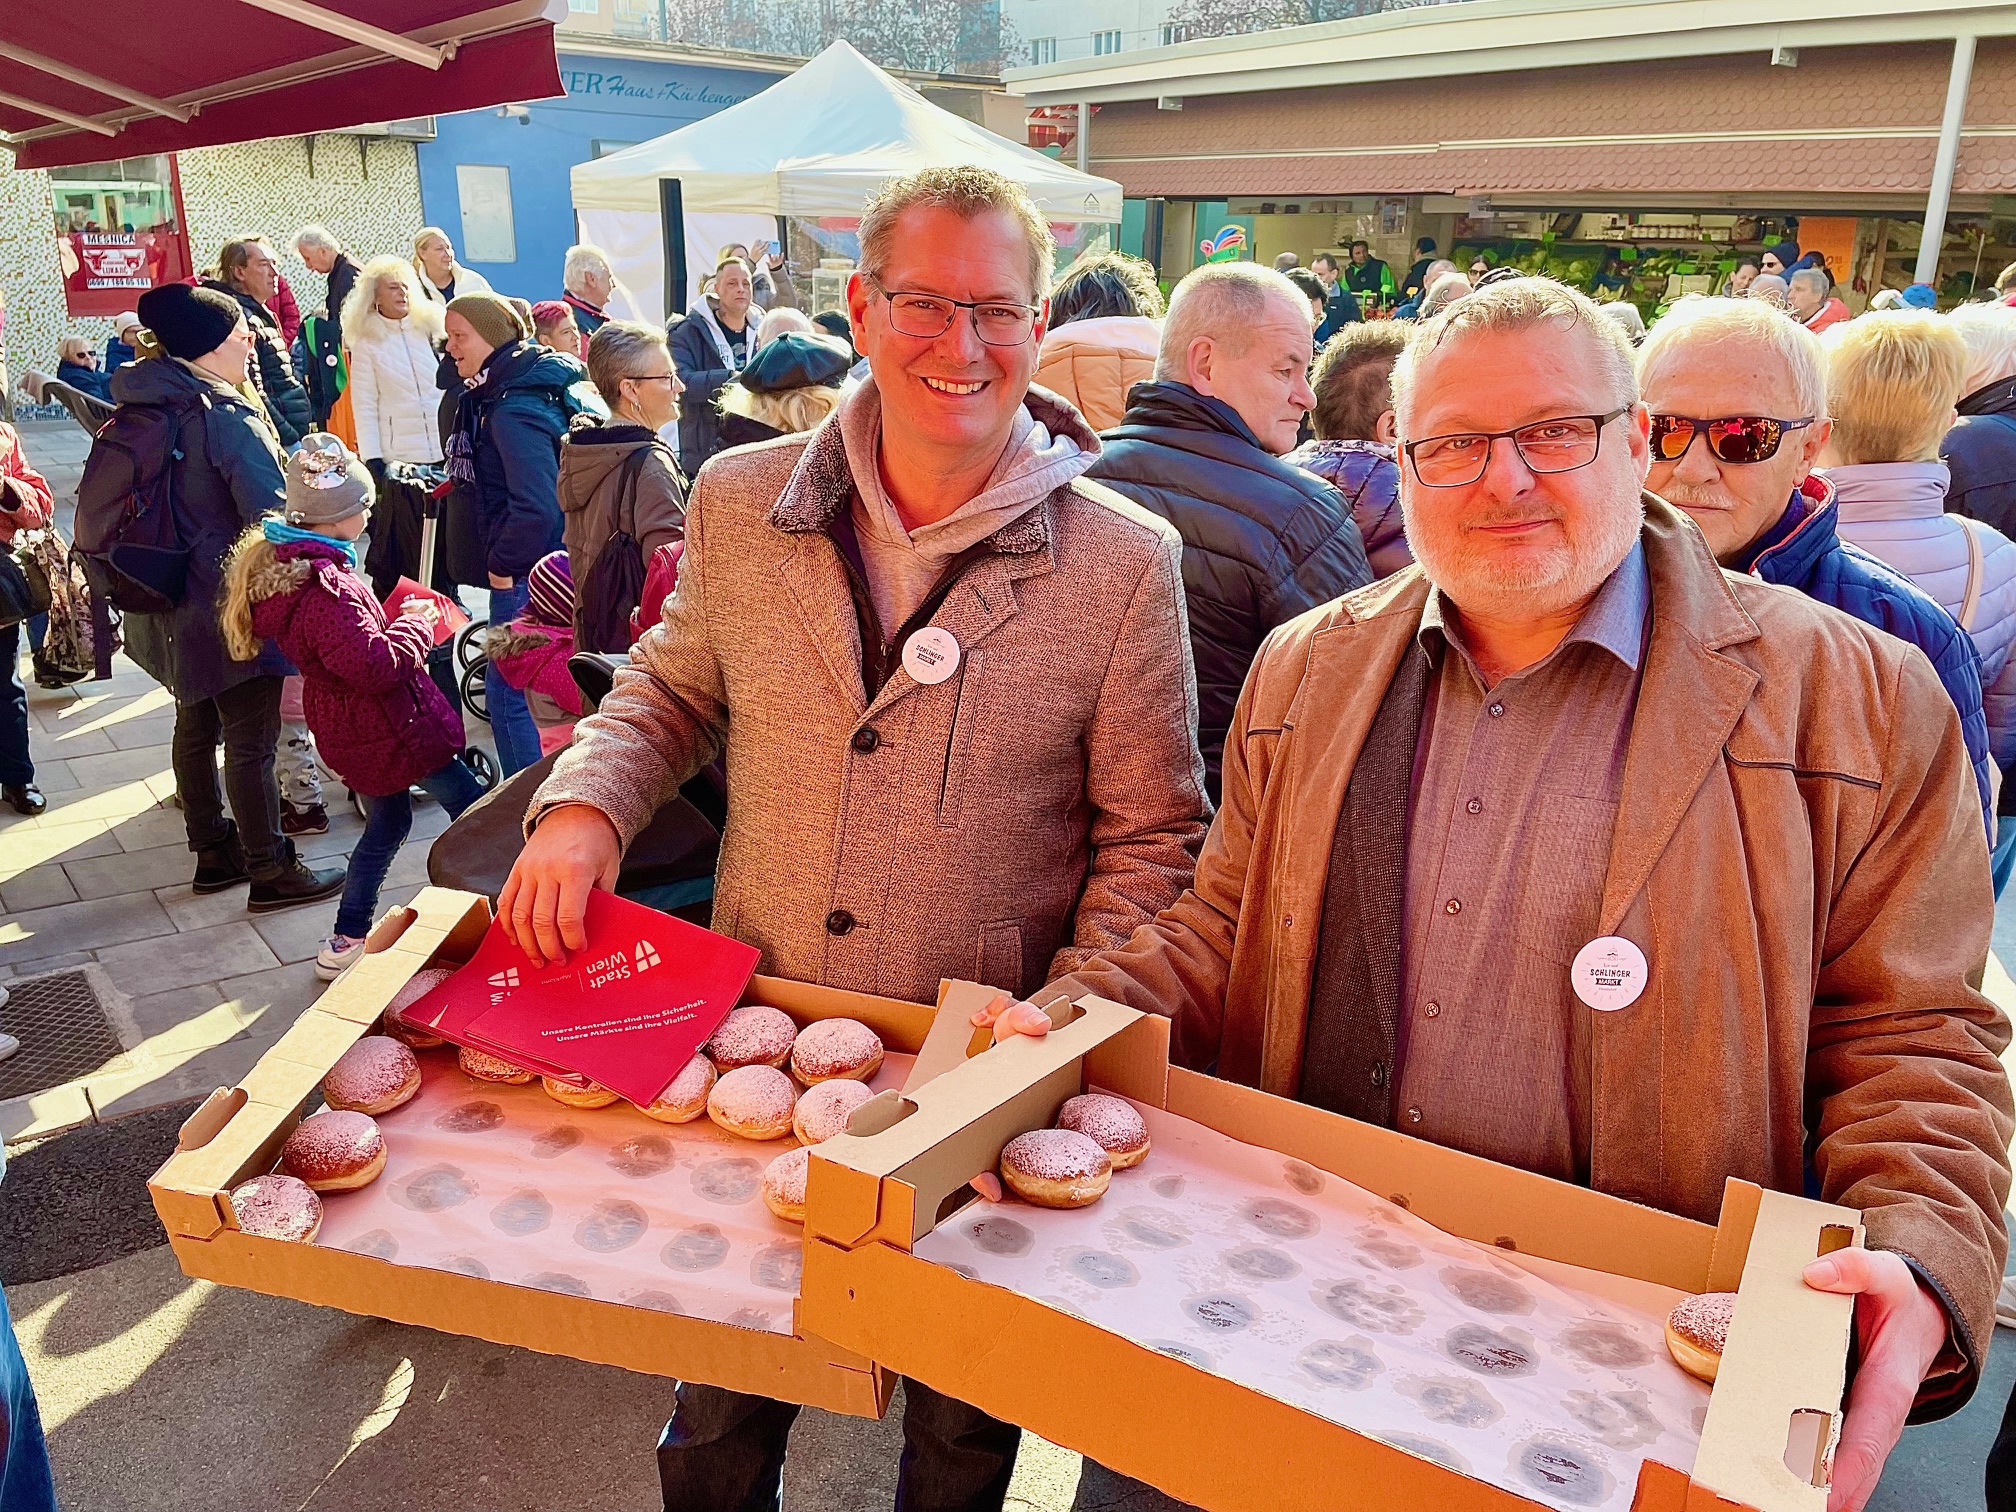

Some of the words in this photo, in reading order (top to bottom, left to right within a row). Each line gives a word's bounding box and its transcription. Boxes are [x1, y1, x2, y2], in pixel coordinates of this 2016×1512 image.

[87, 234, 135, 244] MESNICA
[915, 644, 945, 662] SCHLINGER
[586, 951, 628, 975] Wien
[1590, 968, 1631, 978] SCHLINGER
[589, 964, 632, 989] Stadt
[541, 1026, 573, 1036] Unsere
[575, 1019, 622, 1031] Kontrollen
[624, 1015, 641, 1024] sind
[661, 999, 707, 1017] Sicherheit.
[556, 1032, 588, 1042] Unsere
[590, 1027, 623, 1037] Märkte
[624, 1023, 643, 1032] sind
[663, 1013, 698, 1026] Vielfalt.
